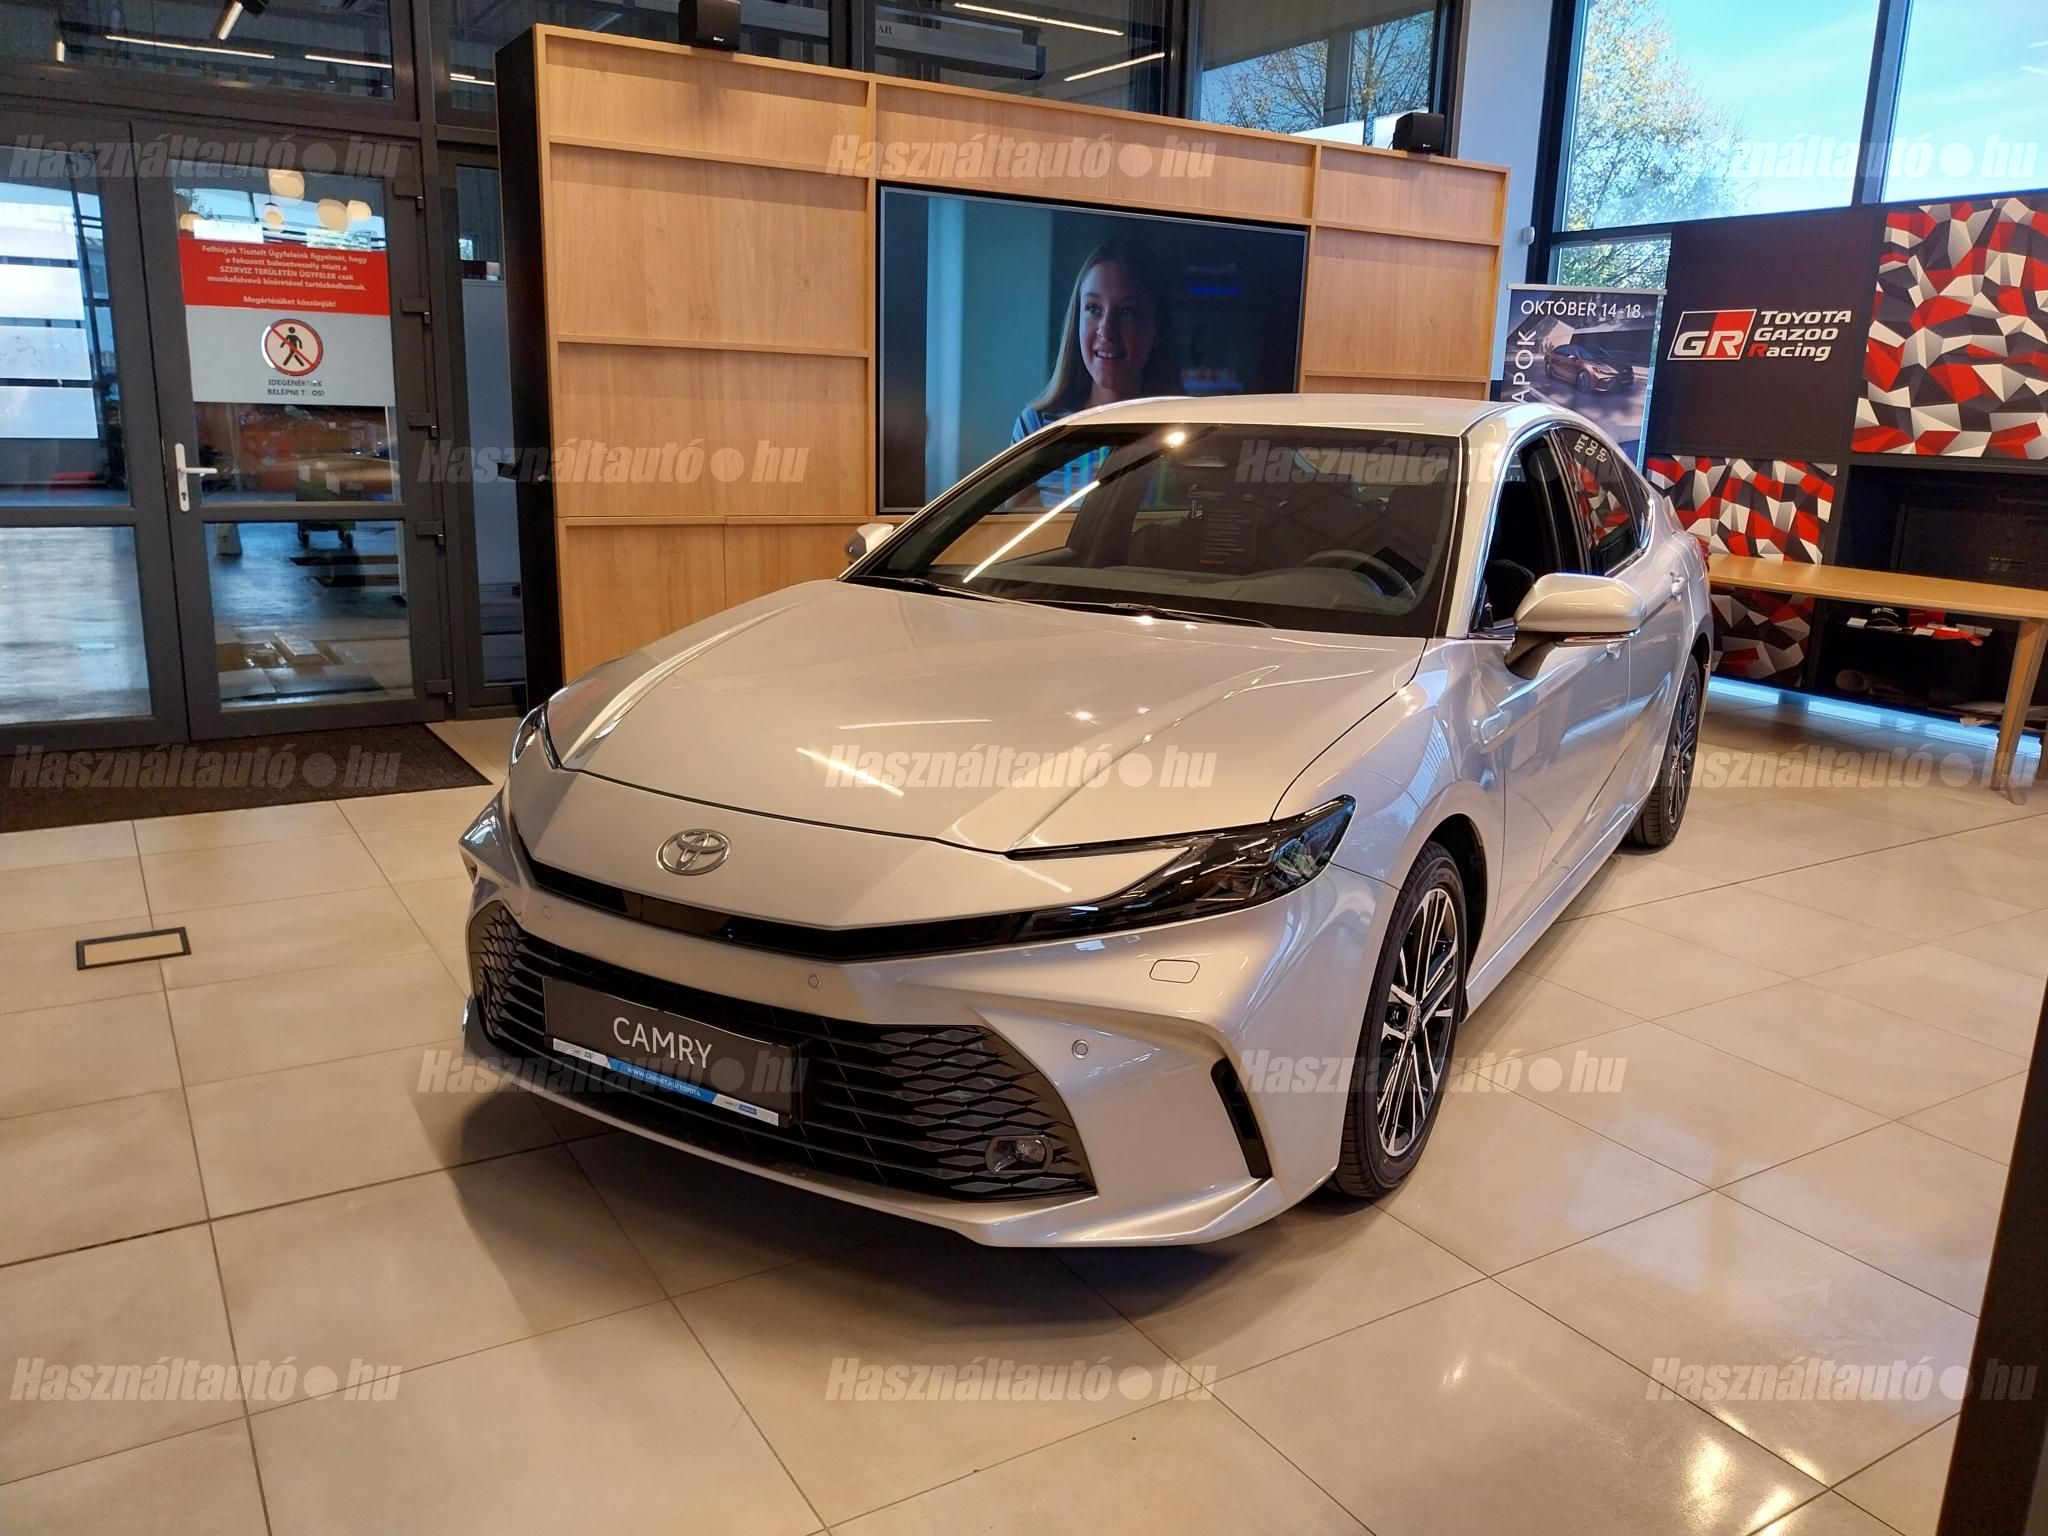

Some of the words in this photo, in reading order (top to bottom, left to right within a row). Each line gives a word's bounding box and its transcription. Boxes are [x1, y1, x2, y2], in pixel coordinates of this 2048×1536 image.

[875, 24, 893, 34] AR
[349, 256, 367, 264] hogy
[219, 266, 253, 274] SZERVIZ
[299, 270, 336, 279] ÜGYFELEK
[1521, 298, 1597, 317] OKTÓBER
[1601, 303, 1645, 319] 14-18.
[1761, 310, 1852, 325] TOYOTA
[1754, 327, 1839, 342] GAZOO
[1674, 331, 1744, 357] GR
[1748, 343, 1832, 362] Racing
[1511, 330, 1537, 403] APOK
[613, 1017, 712, 1069] CAMRY
